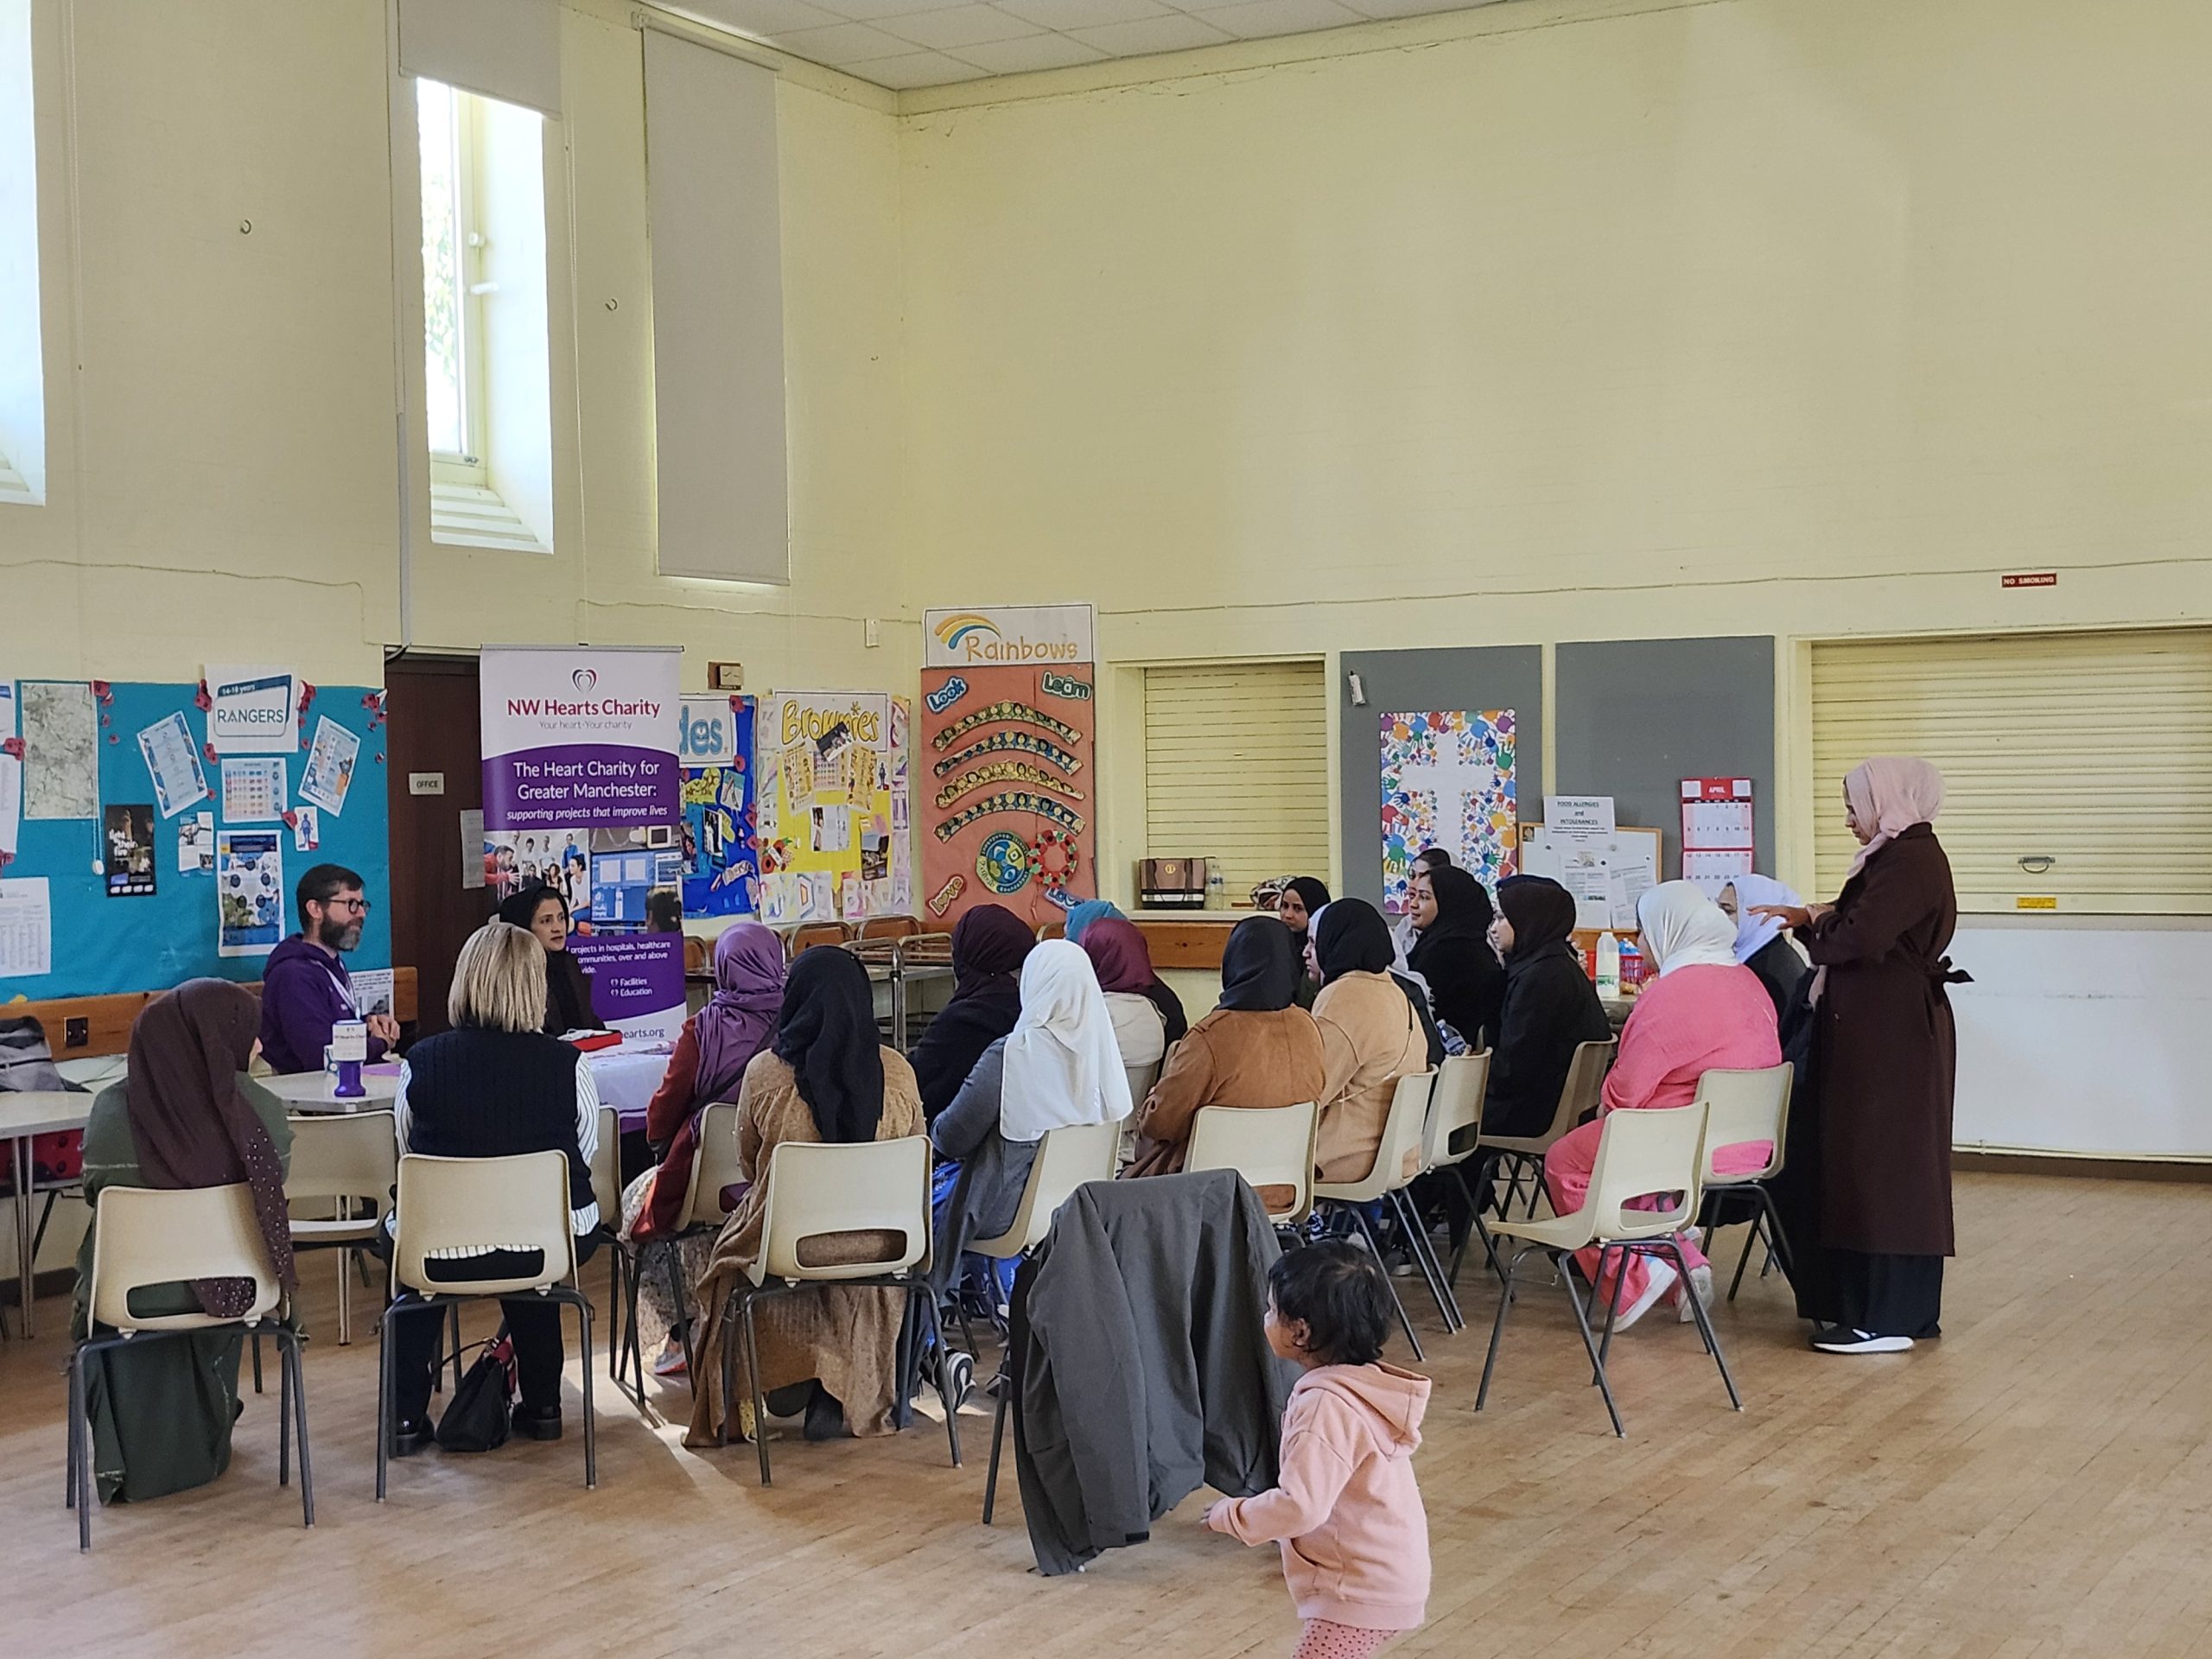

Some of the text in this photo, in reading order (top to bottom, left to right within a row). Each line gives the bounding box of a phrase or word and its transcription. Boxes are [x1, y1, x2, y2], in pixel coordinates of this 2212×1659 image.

[2018, 575, 2055, 584] SMOKING
[965, 636, 1078, 662] Rainbows
[929, 673, 1089, 710] Look Learn
[507, 698, 660, 718] NW Hearts Charity
[217, 709, 284, 723] RANGERS
[512, 760, 660, 779] The Heart Charity for
[518, 782, 657, 800] Greater Manchester:
[506, 804, 668, 823] supporting projects that improve lives
[598, 944, 605, 953] in
[637, 941, 671, 950] healthcare
[577, 953, 618, 964] ommunities,
[634, 951, 647, 960] and
[648, 950, 669, 960] above
[620, 976, 648, 987] Facilities
[620, 987, 653, 997] Education
[622, 1028, 664, 1039] earts.org
